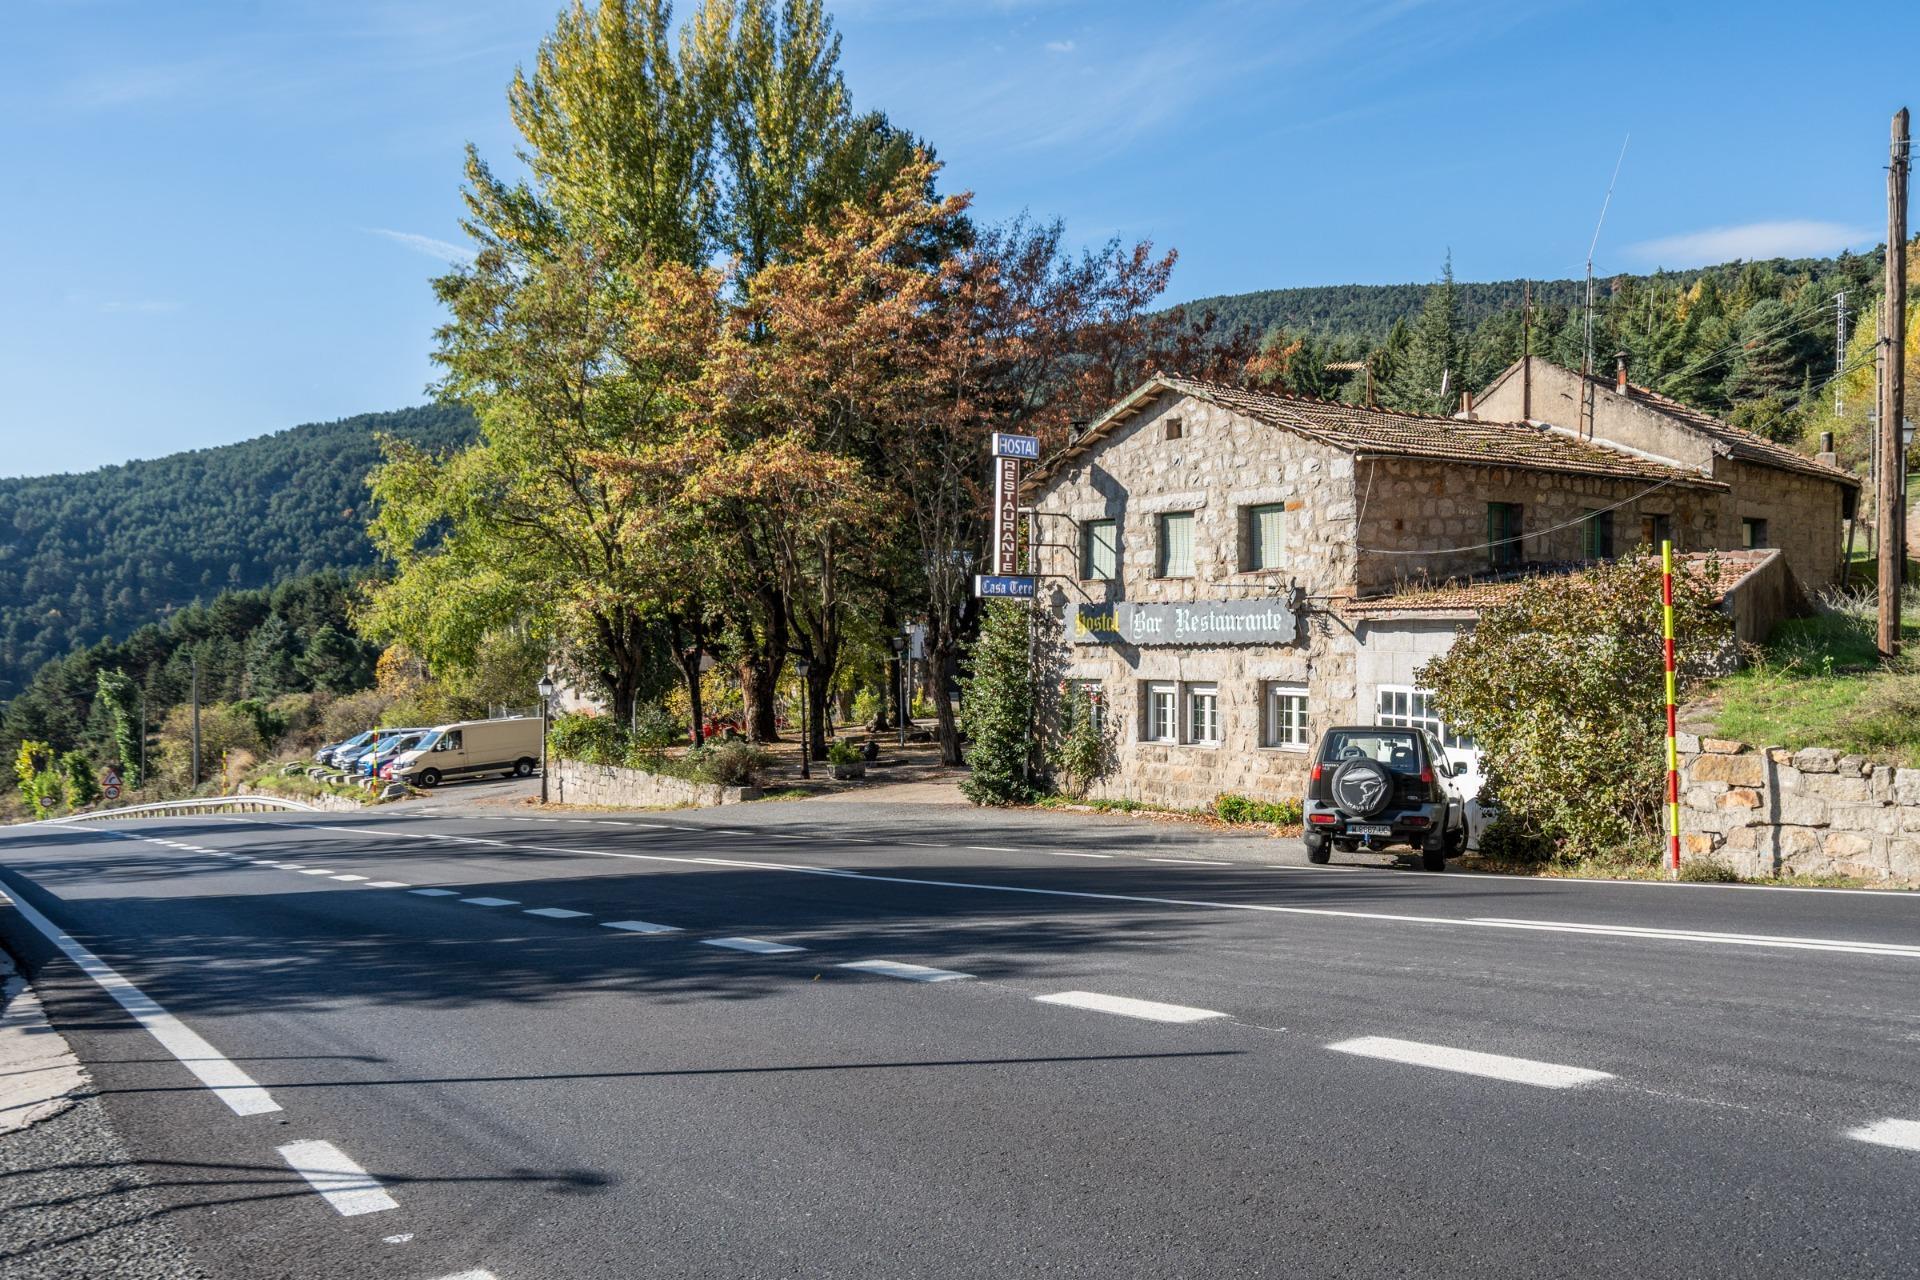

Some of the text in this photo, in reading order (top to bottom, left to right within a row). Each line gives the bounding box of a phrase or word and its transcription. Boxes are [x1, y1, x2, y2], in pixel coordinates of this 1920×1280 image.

[999, 437, 1037, 455] HOSTAL
[1002, 460, 1016, 572] RESTAURANTE
[981, 580, 1032, 595] Casa Tere
[1074, 608, 1282, 640] Hostal Bar Restaurante
